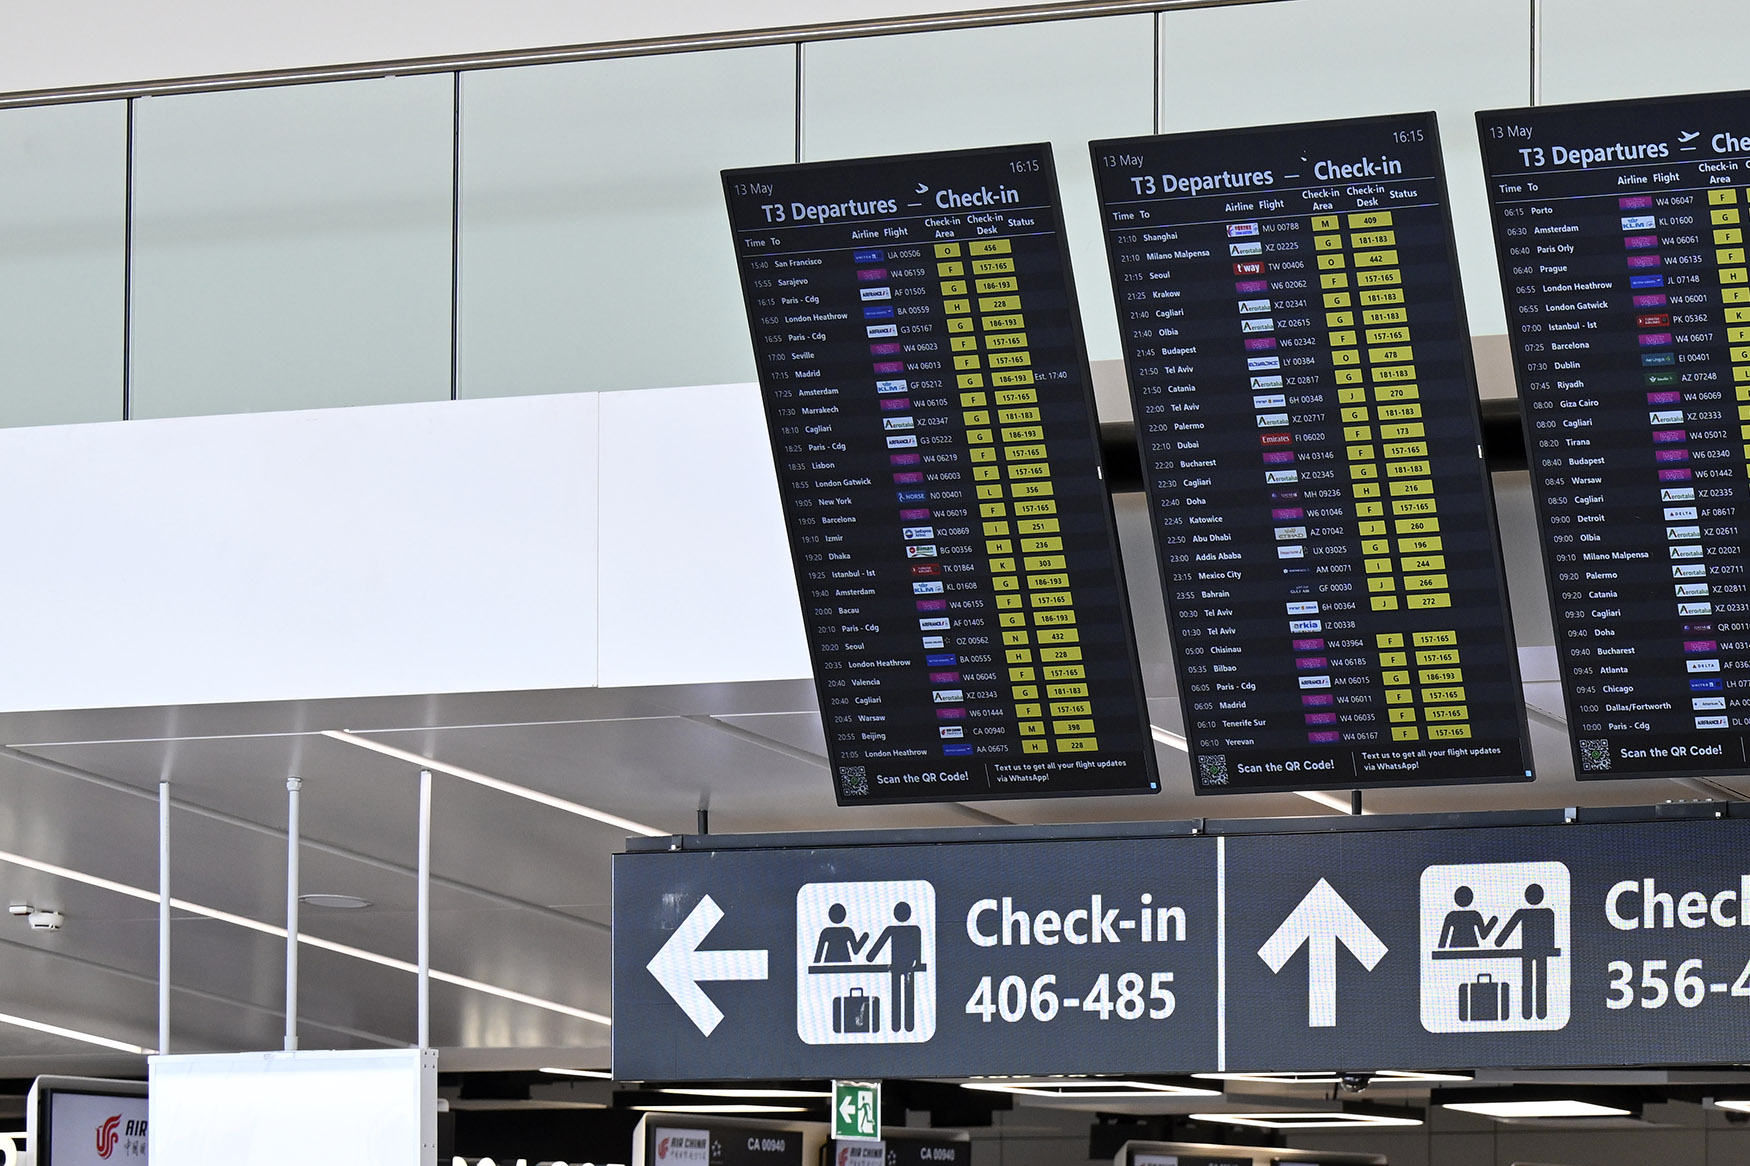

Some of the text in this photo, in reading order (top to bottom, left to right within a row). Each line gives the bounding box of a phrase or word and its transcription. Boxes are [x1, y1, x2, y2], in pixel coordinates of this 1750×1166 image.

[1392, 129, 1424, 144] 16:15
[1489, 124, 1533, 140] 13 May
[1103, 154, 1144, 169] 13 May
[1518, 147, 1546, 167] T3
[1552, 140, 1669, 169] Departures
[1009, 159, 1040, 174] 16:15
[1130, 155, 1403, 196] T3 Departures Check-in
[734, 182, 774, 197] 13 May
[760, 184, 1020, 224] T3 Departures Check-in
[1503, 207, 1525, 217] 06:15
[1530, 206, 1554, 215] Porto
[1655, 197, 1670, 206] W4
[1670, 195, 1694, 206] 06047
[1719, 193, 1725, 202] F
[750, 244, 997, 270] 15:40 San Francisco UA 00506 456
[1124, 272, 1144, 282] 21:15
[1149, 270, 1171, 280] Seoul
[1267, 262, 1281, 271] TW
[1281, 260, 1305, 270] 00406
[1369, 255, 1383, 263] 442
[1034, 370, 1068, 381] Est. 17:40
[967, 893, 1186, 947] Check-in
[966, 972, 1175, 1022] 406-485
[125, 1120, 148, 1136] AIR
[670, 1138, 707, 1151] AIR CHINA
[747, 1138, 785, 1152] CA 00940
